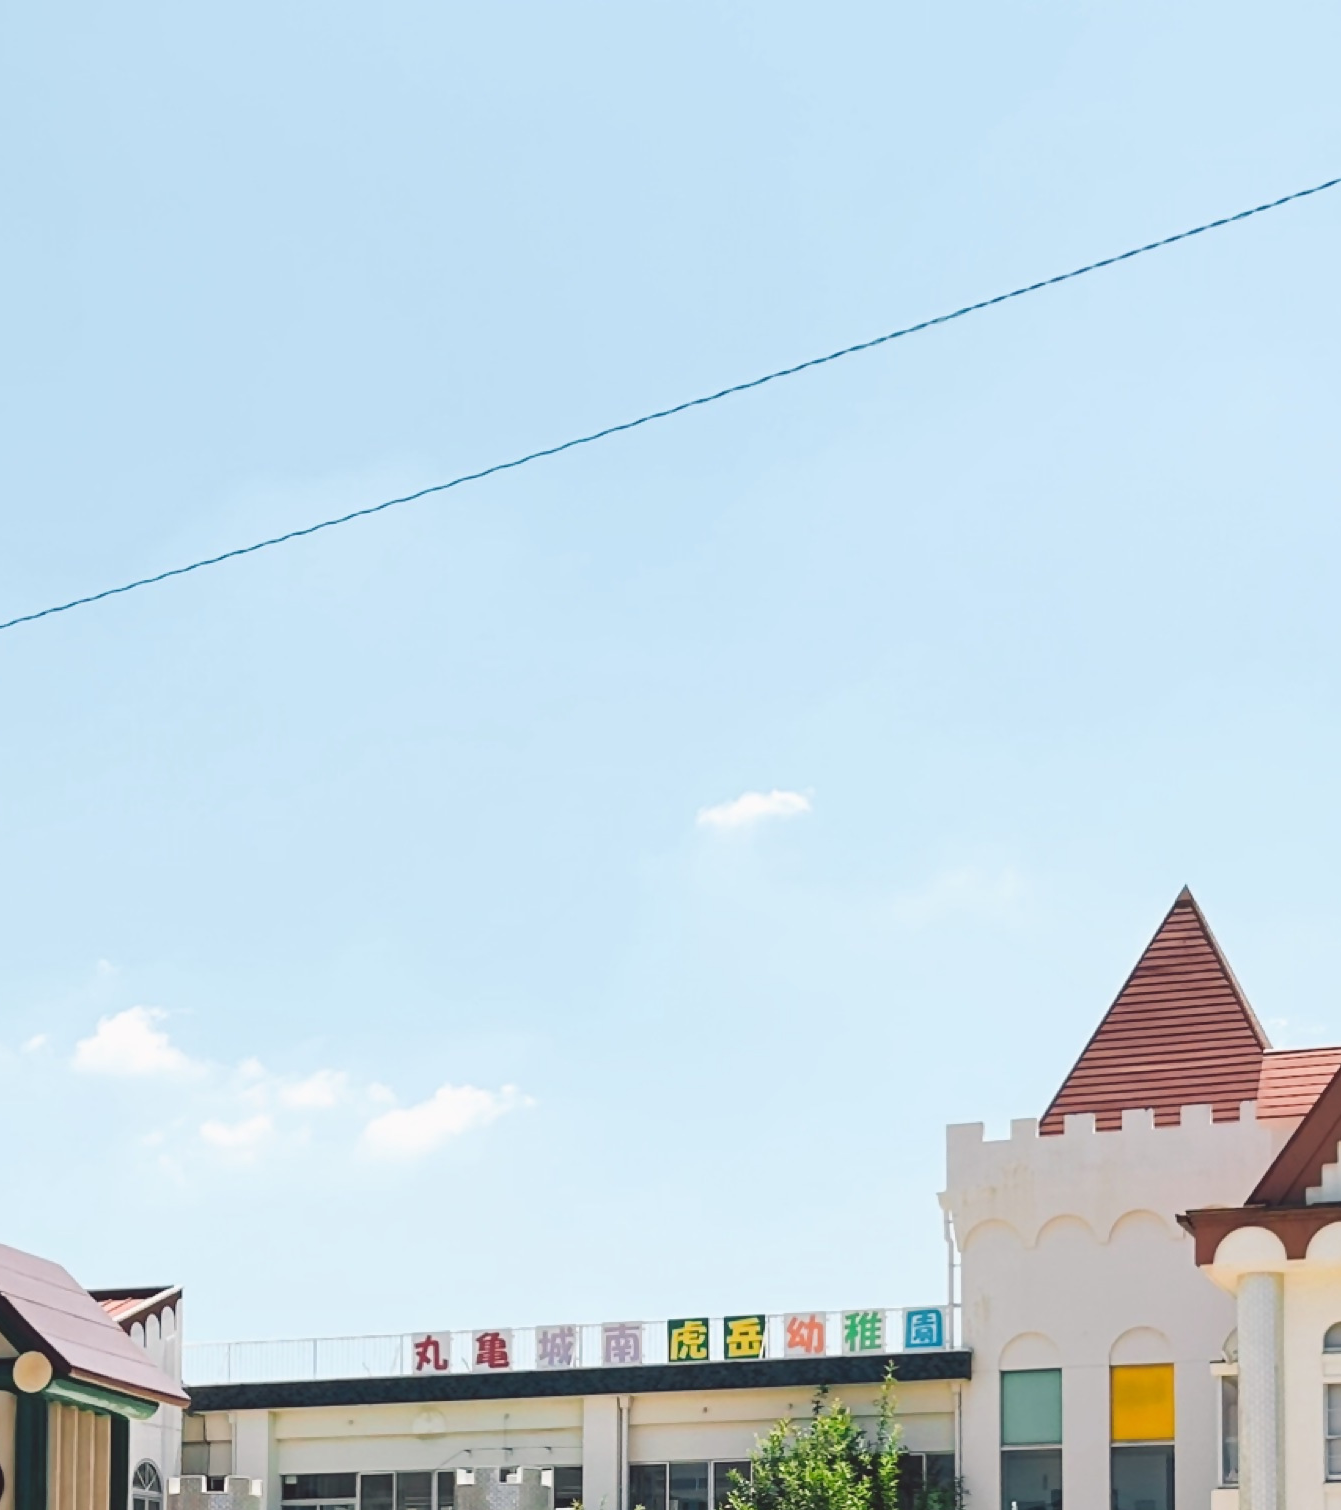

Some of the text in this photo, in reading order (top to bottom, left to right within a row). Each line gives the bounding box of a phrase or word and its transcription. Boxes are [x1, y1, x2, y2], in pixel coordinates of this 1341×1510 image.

[413, 1308, 944, 1372] 丸亀城南虎岳幼稚園
